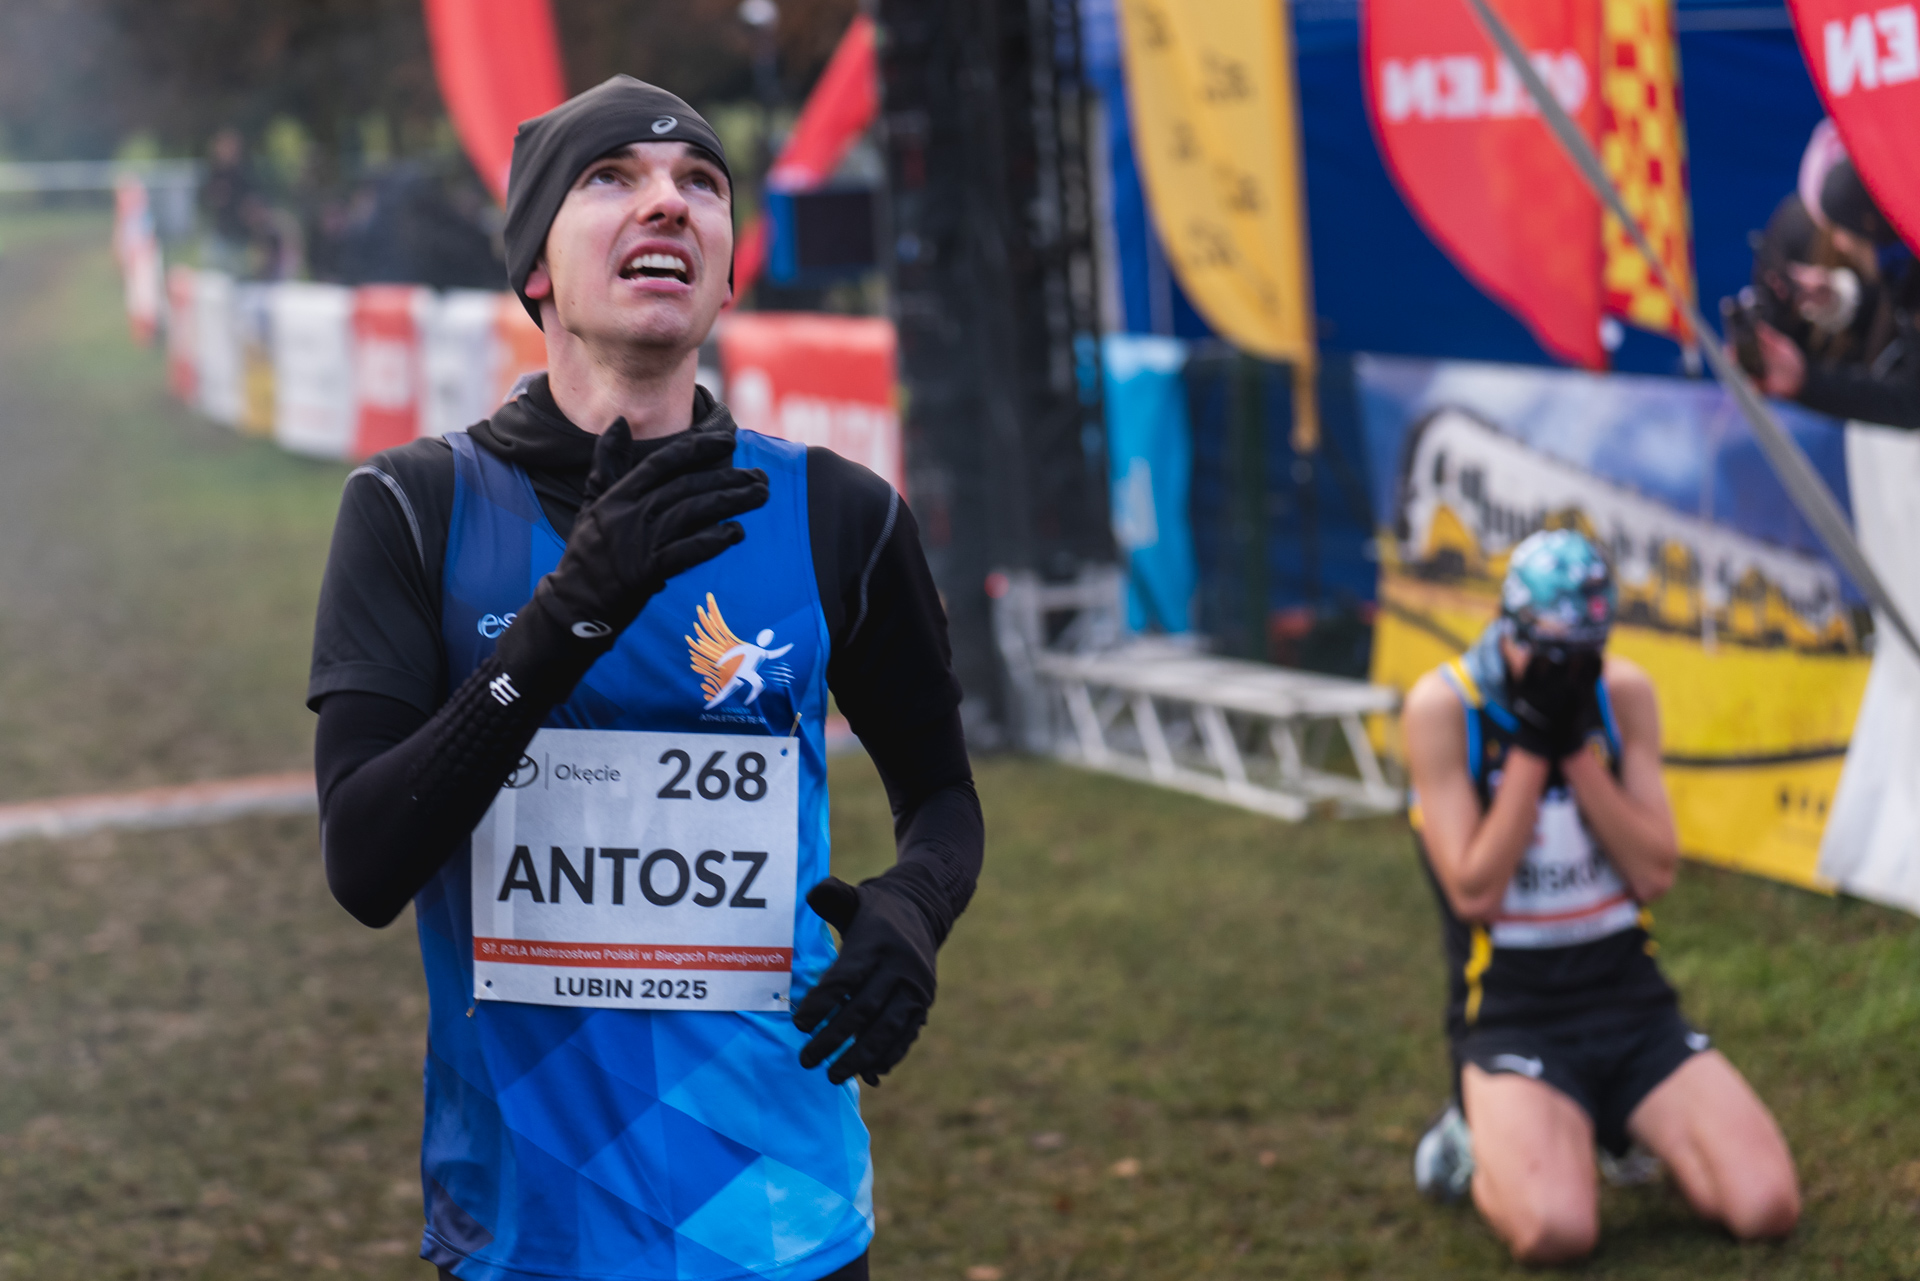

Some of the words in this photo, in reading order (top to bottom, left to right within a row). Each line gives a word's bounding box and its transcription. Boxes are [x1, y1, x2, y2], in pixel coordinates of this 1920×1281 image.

[554, 763, 621, 785] Okęcie
[657, 748, 768, 802] 268
[497, 845, 769, 909] ANTOSZ
[481, 942, 499, 955] 97.
[501, 944, 529, 957] PZLA
[530, 946, 602, 960] Mistrzostwa
[604, 949, 640, 961] Polski
[641, 951, 653, 961] w
[655, 950, 706, 965] Biegach
[554, 976, 633, 998] LUBIN
[640, 978, 708, 999] 2025
